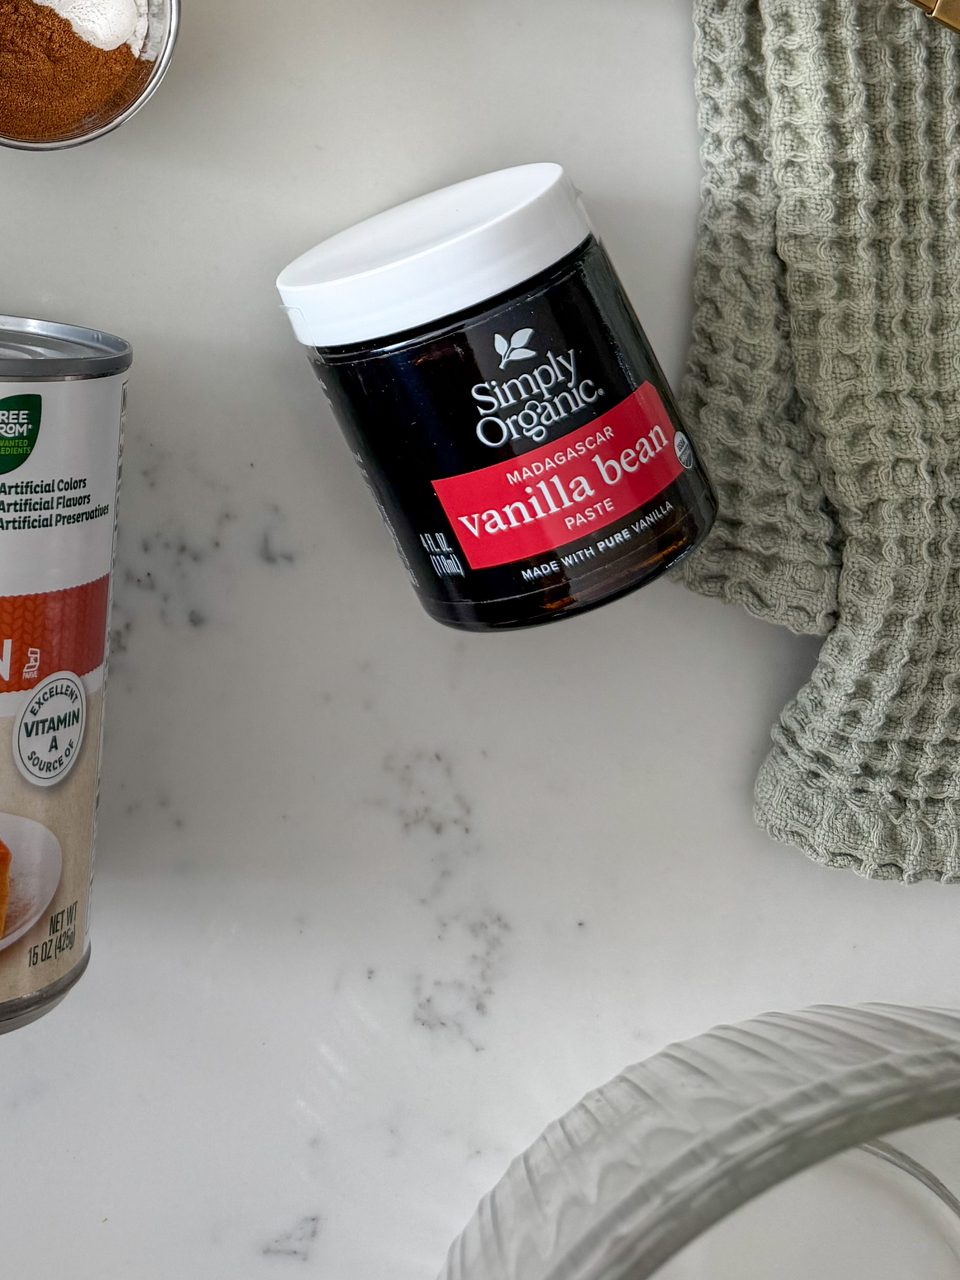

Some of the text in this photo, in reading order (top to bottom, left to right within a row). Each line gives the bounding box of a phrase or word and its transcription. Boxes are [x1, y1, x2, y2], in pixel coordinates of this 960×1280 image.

[471, 349, 574, 416] Simply
[506, 426, 614, 485] MADAGASCAR
[57, 477, 87, 493] Colors
[458, 424, 669, 538] vanilla bean
[55, 503, 109, 527] Preservatives
[56, 493, 91, 510] Flavors
[564, 498, 614, 530] PASTE
[521, 501, 674, 581] MADE WITH PURE VANILLA
[30, 684, 78, 716] EXCELLENT
[24, 708, 80, 738] VITAMIN
[27, 738, 75, 773] SOURCE OF
[48, 735, 59, 752] A
[49, 900, 78, 936] NET WT
[28, 945, 39, 968] 15
[41, 938, 53, 962] OZ
